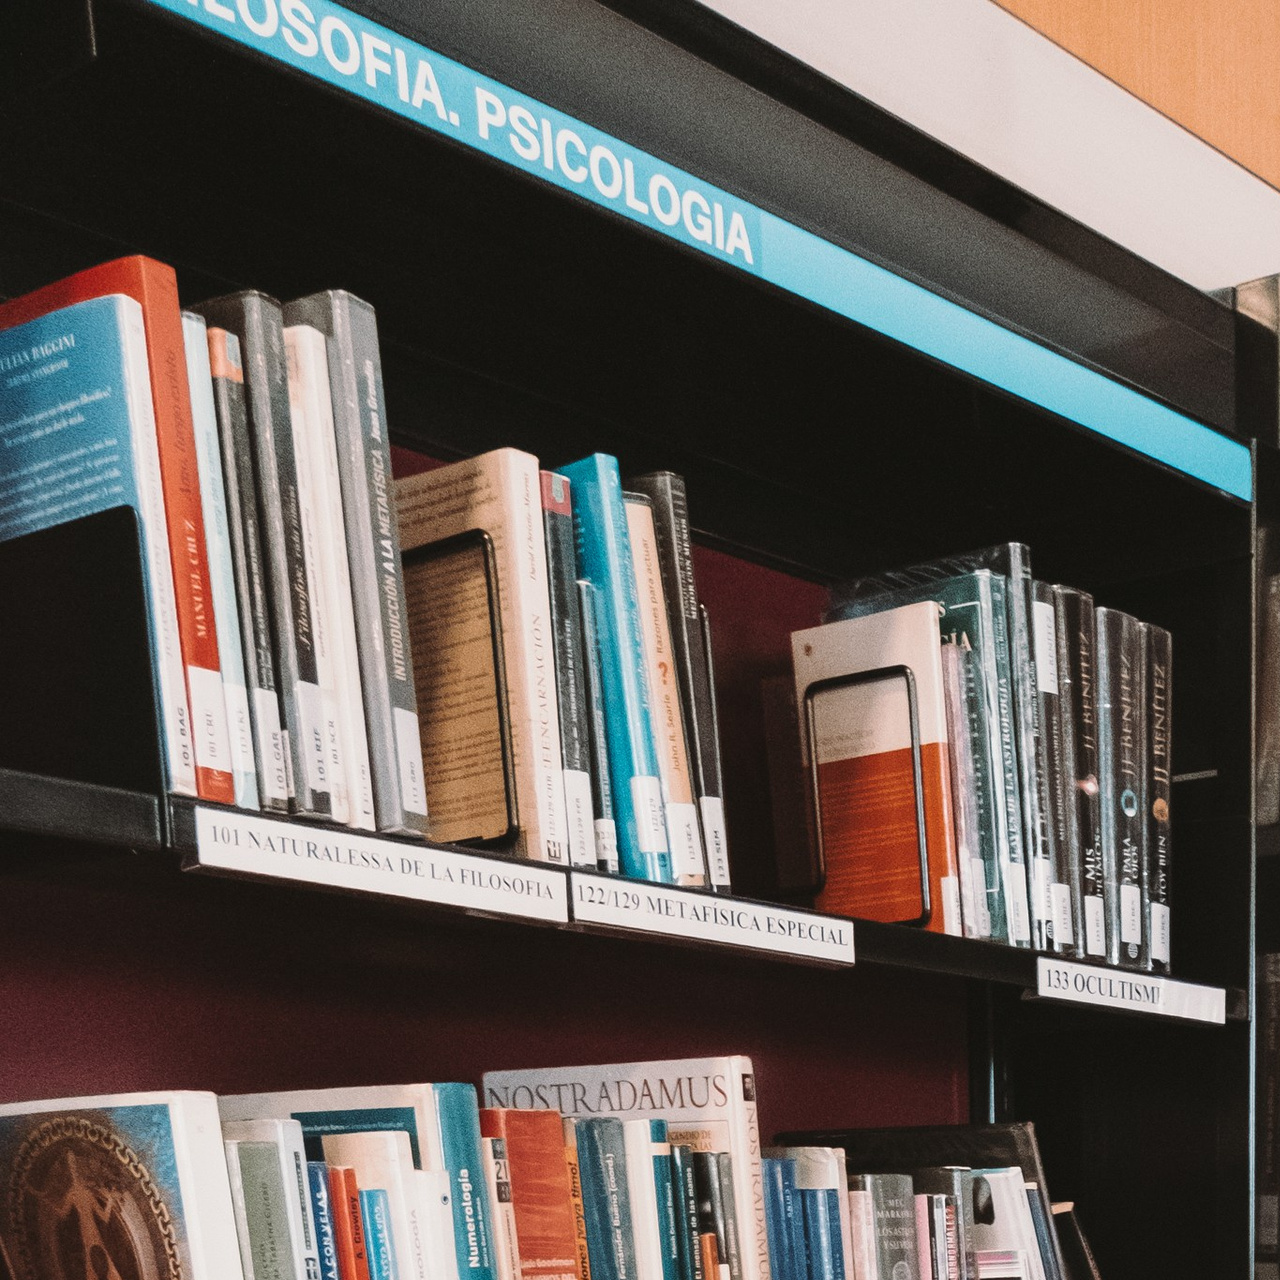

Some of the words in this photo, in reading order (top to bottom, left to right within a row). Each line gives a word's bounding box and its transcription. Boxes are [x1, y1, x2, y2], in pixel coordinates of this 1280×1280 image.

[475, 87, 754, 264] PSICOLOGIA
[371, 449, 394, 536] METAFÍSICA
[184, 520, 200, 567] CRUZ
[381, 539, 395, 560] LA
[640, 537, 656, 575] actuar
[384, 562, 396, 573] A
[189, 572, 208, 638] MANUEL
[648, 578, 660, 604] para
[384, 575, 407, 680] INTRODUCCIÓN
[650, 607, 665, 653] Razones
[176, 707, 188, 739] BAG
[663, 694, 676, 729] Searle
[1154, 665, 1166, 755] BENÍTEZ
[270, 732, 282, 762] GAR
[313, 728, 324, 753] RIF
[668, 731, 678, 742] R.
[316, 757, 325, 782] 101
[670, 745, 681, 771] John
[1154, 768, 1167, 783] JJ
[211, 825, 240, 846] 101
[247, 830, 394, 875] NATURALESSA
[399, 855, 424, 877] DE
[430, 860, 456, 881] LA
[460, 868, 554, 901] FILOSOFIA
[1084, 849, 1095, 879] MIS
[1156, 836, 1167, 865] BIEN
[577, 882, 641, 912] 122/129
[645, 896, 762, 931] METAFÍSICA
[766, 914, 849, 946] ESPECIAL
[1046, 968, 1071, 990] 133
[488, 1074, 728, 1116] NOSTRADAMUS
[566, 1161, 582, 1200] timo!
[685, 1167, 694, 1197] manos
[316, 1191, 332, 1233] VELAS
[458, 1169, 482, 1267] Numerología
[571, 1204, 588, 1241] ¡vaya
[608, 1193, 621, 1226] Bueno
[687, 1201, 696, 1214] las
[323, 1237, 336, 1266] CON
[612, 1229, 627, 1279] Fernández
[690, 1231, 703, 1267] mensaje
